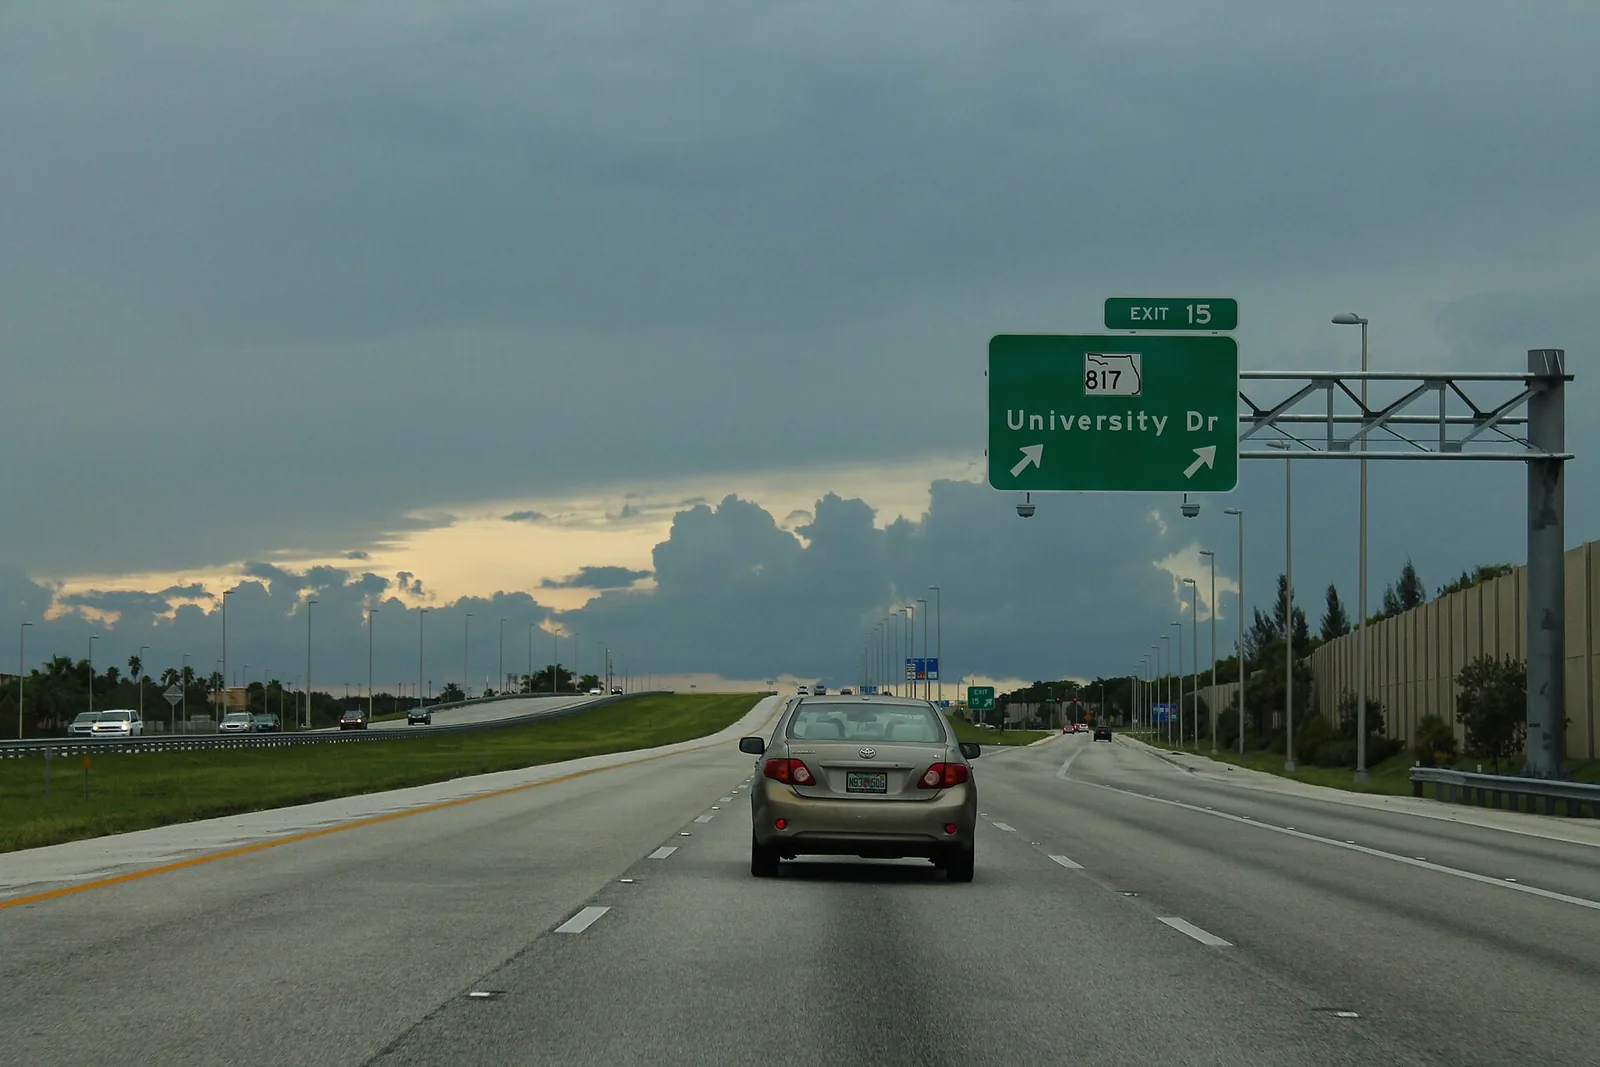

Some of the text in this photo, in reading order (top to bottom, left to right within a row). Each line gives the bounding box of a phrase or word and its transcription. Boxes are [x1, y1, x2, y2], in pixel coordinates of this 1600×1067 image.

[1130, 304, 1211, 324] EXIT 15
[1085, 370, 1121, 390] 817
[1007, 409, 1219, 436] University Dr
[972, 697, 980, 705] 15
